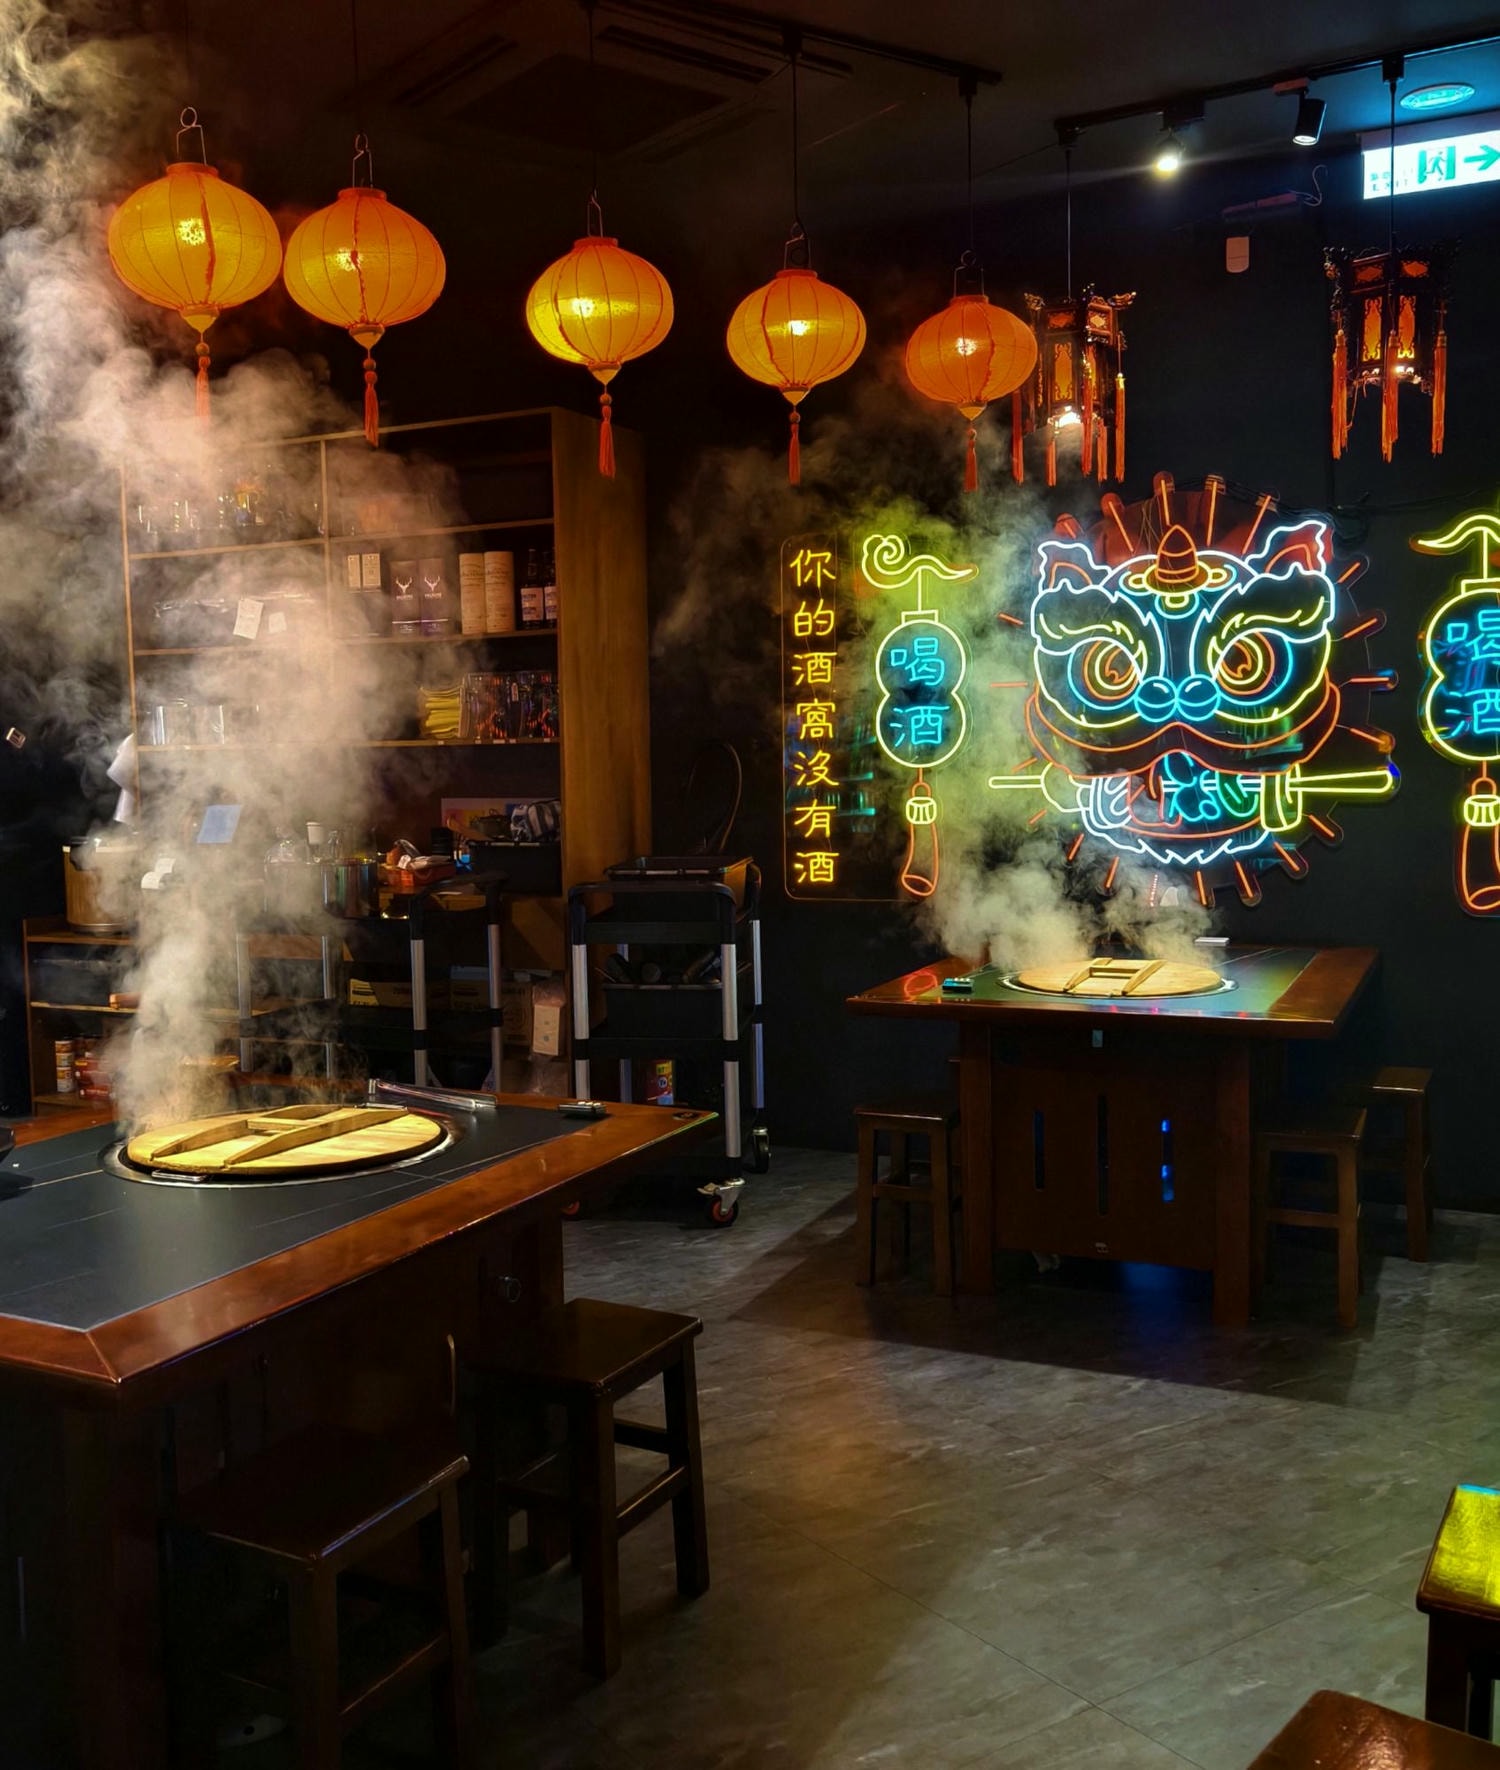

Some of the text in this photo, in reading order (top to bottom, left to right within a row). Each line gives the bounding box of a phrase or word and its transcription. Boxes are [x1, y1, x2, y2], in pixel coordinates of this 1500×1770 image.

[789, 548, 839, 884] 你的酒窩沒有酒
[889, 636, 950, 748] 喝酒
